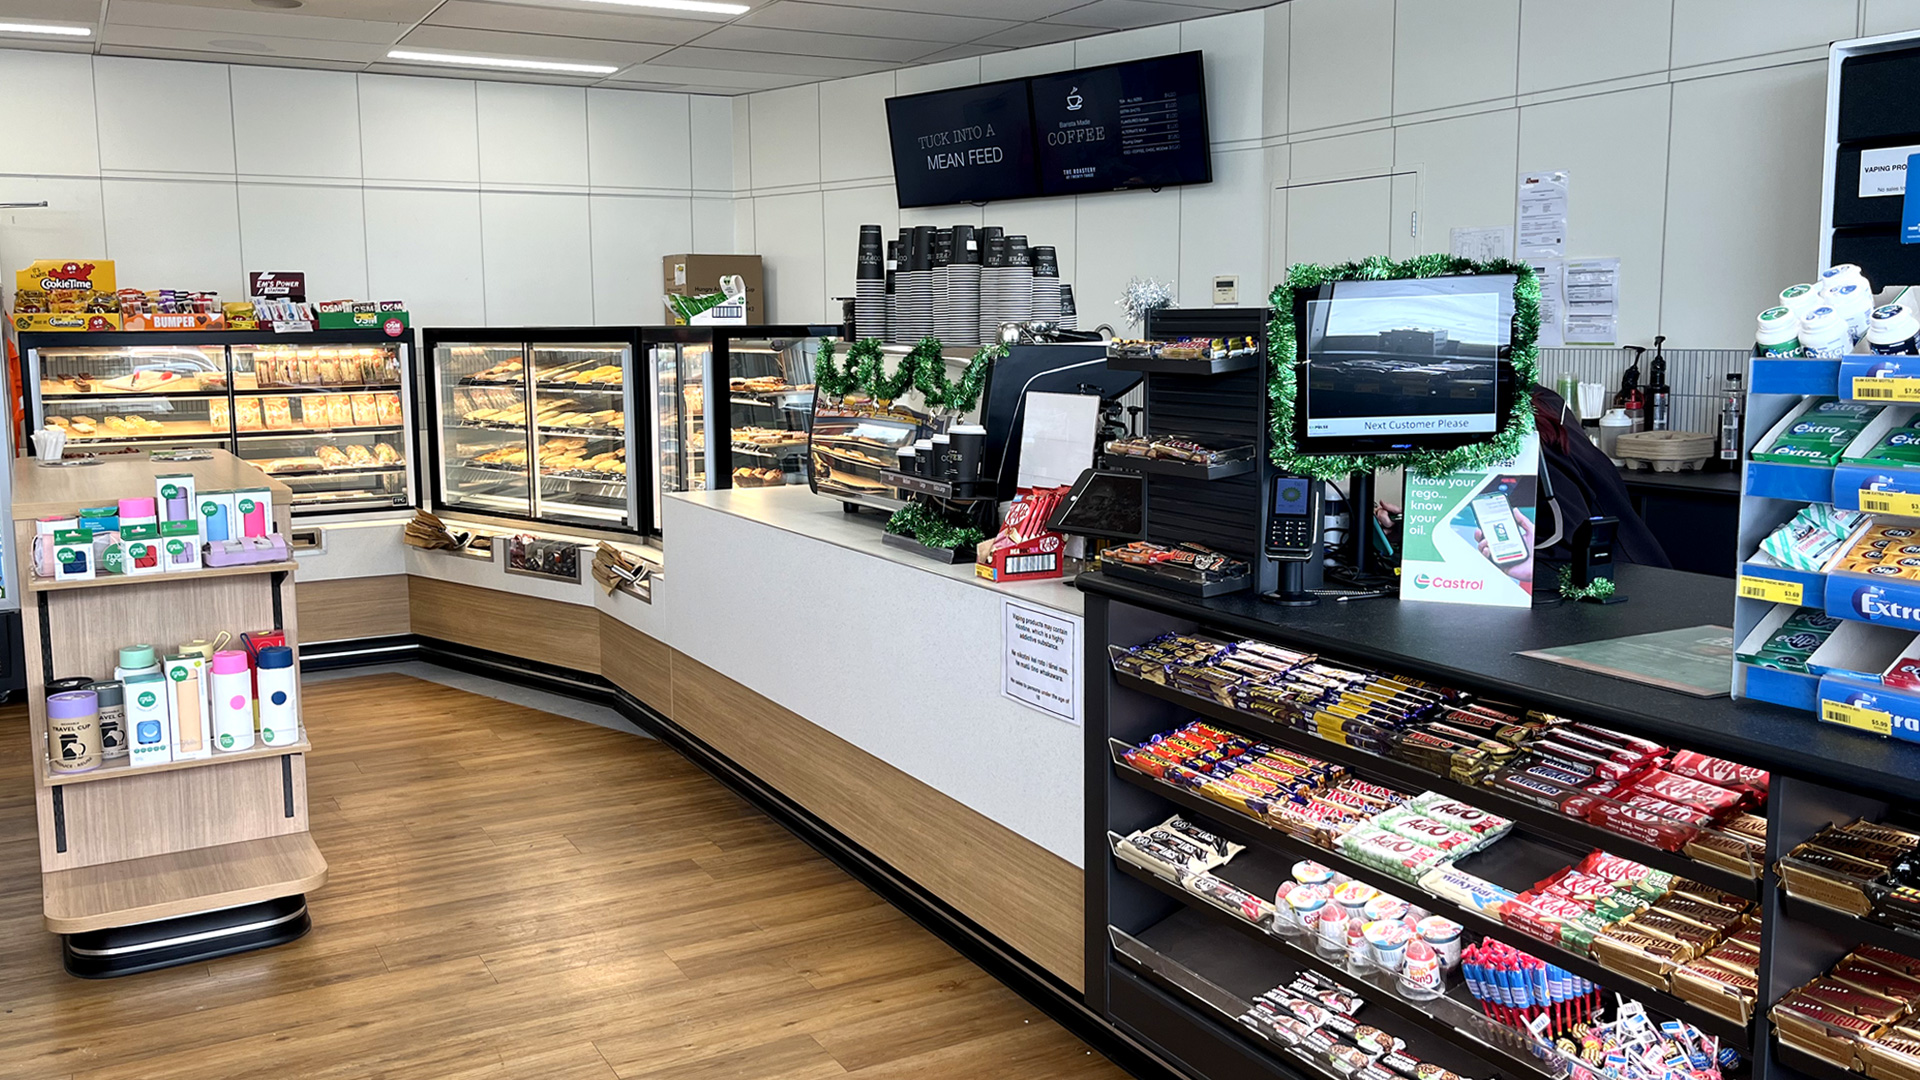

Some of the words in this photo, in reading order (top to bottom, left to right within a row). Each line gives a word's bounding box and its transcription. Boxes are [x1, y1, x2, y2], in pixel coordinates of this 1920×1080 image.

[1059, 121, 1076, 129] Barista
[917, 131, 950, 150] TUCK
[953, 125, 982, 144] INTO
[986, 123, 996, 137] A
[1047, 126, 1105, 146] COFFEE
[927, 151, 965, 170] MEAN
[968, 146, 1003, 165] FEED
[1073, 166, 1096, 174] ROASTERY
[1864, 165, 1891, 173] VAPING
[256, 280, 275, 288] EM'S
[275, 280, 300, 288] POWER
[321, 304, 344, 313] OSM
[153, 316, 195, 328] BUMPER
[1818, 402, 1866, 413] extra
[1364, 421, 1386, 430] Next
[1388, 420, 1435, 430] Customer
[1437, 419, 1469, 429] Please
[1793, 422, 1841, 435] extra
[1890, 434, 1920, 446] ext
[1774, 447, 1821, 458] extra
[1412, 475, 1446, 486] Know
[1448, 476, 1476, 488] your
[1411, 489, 1448, 500] rego...
[1411, 501, 1443, 511] know
[1409, 515, 1437, 525] your
[1409, 525, 1426, 536] oil.
[1432, 576, 1483, 591] Castrol
[1784, 590, 1800, 598] $3.69
[1012, 613, 1025, 624] Vaping
[1025, 618, 1044, 628] products
[1044, 623, 1052, 631] may
[1053, 626, 1068, 635] contain
[1019, 633, 1037, 643] addictive
[1037, 639, 1059, 650] substance.
[1052, 634, 1064, 645] highly
[1027, 685, 1041, 694] persons
[1446, 710, 1496, 727] Mars
[1871, 719, 1888, 728] $5.99
[77, 723, 91, 731] CUP
[1166, 736, 1202, 752] PICNIC
[1407, 732, 1455, 749] Mars
[1137, 751, 1170, 767] PICNIC
[1257, 757, 1307, 775] crunchie
[1241, 764, 1291, 783] crunchie
[1530, 766, 1582, 784] SNICKERS
[1702, 757, 1762, 781] KitKat
[1230, 773, 1277, 794] crunchie
[1351, 778, 1393, 796] TWIX
[1510, 775, 1560, 794] SNICKERS
[1659, 777, 1722, 800] KitKat
[1326, 788, 1364, 806] TWIX
[1308, 800, 1343, 818] TWIX
[1430, 802, 1482, 820] Aero
[1624, 796, 1691, 823] KitKat
[1399, 819, 1450, 836] Aero
[1362, 834, 1415, 852] Aero
[1802, 853, 1833, 861] SUPER
[1600, 857, 1648, 881] KitKat
[1567, 877, 1615, 896] KitKat
[1534, 896, 1584, 918] KitKat
[1657, 900, 1706, 917] PEANUT
[1705, 908, 1739, 920] SLAB
[1636, 915, 1680, 932] PEANUT
[1680, 924, 1713, 937] SLAB
[1645, 914, 1672, 922] SUPER
[1604, 931, 1650, 945] PEANUT
[1651, 939, 1683, 951] SLAB
[1849, 966, 1878, 976] SUPER
[1732, 975, 1758, 988] GOL
[1818, 984, 1849, 994] SUPER
[1791, 1001, 1823, 1011] SUPER
[1833, 1015, 1872, 1031] GOLD
[1383, 1056, 1415, 1072] CRISP
